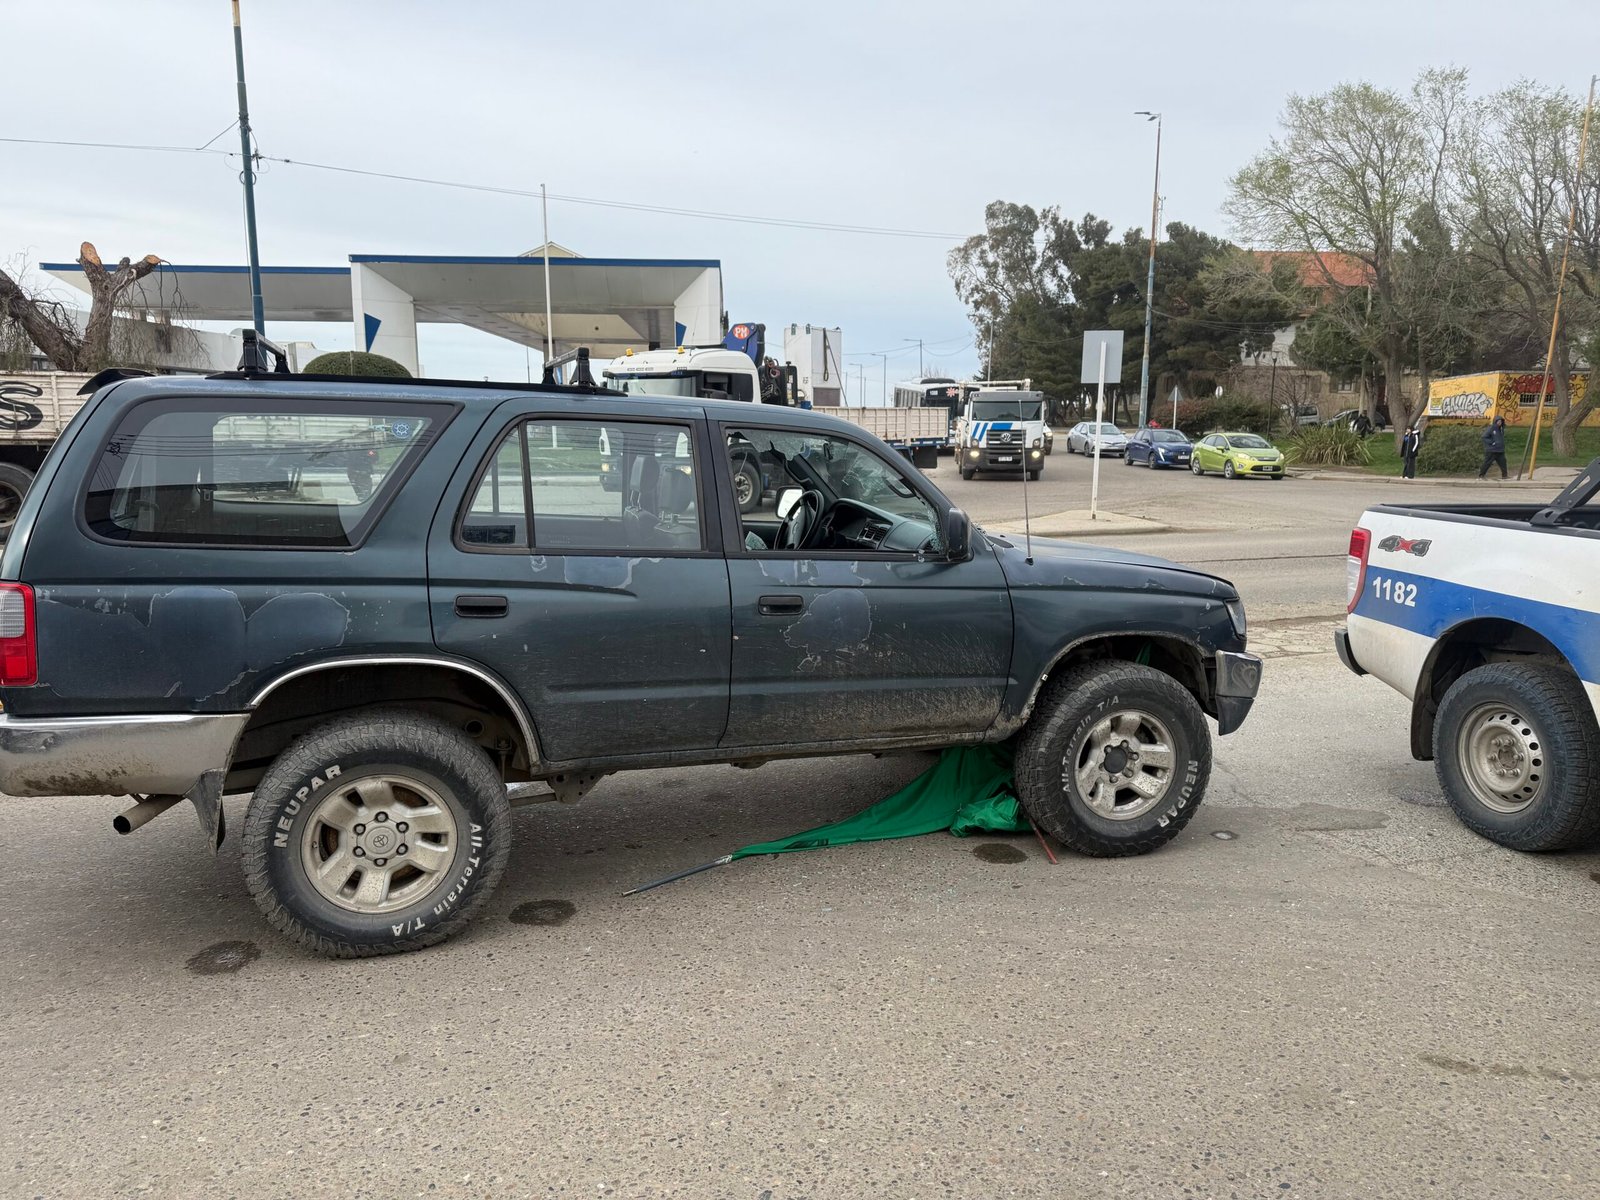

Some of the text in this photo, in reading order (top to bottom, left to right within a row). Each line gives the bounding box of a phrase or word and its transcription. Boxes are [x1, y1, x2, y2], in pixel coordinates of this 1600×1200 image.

[1373, 576, 1417, 607] 1182
[1097, 695, 1119, 711] T/A
[273, 764, 342, 848] NEUPAR
[1157, 760, 1198, 828] NEUPAR
[391, 822, 482, 937] All-Terrain T/A
